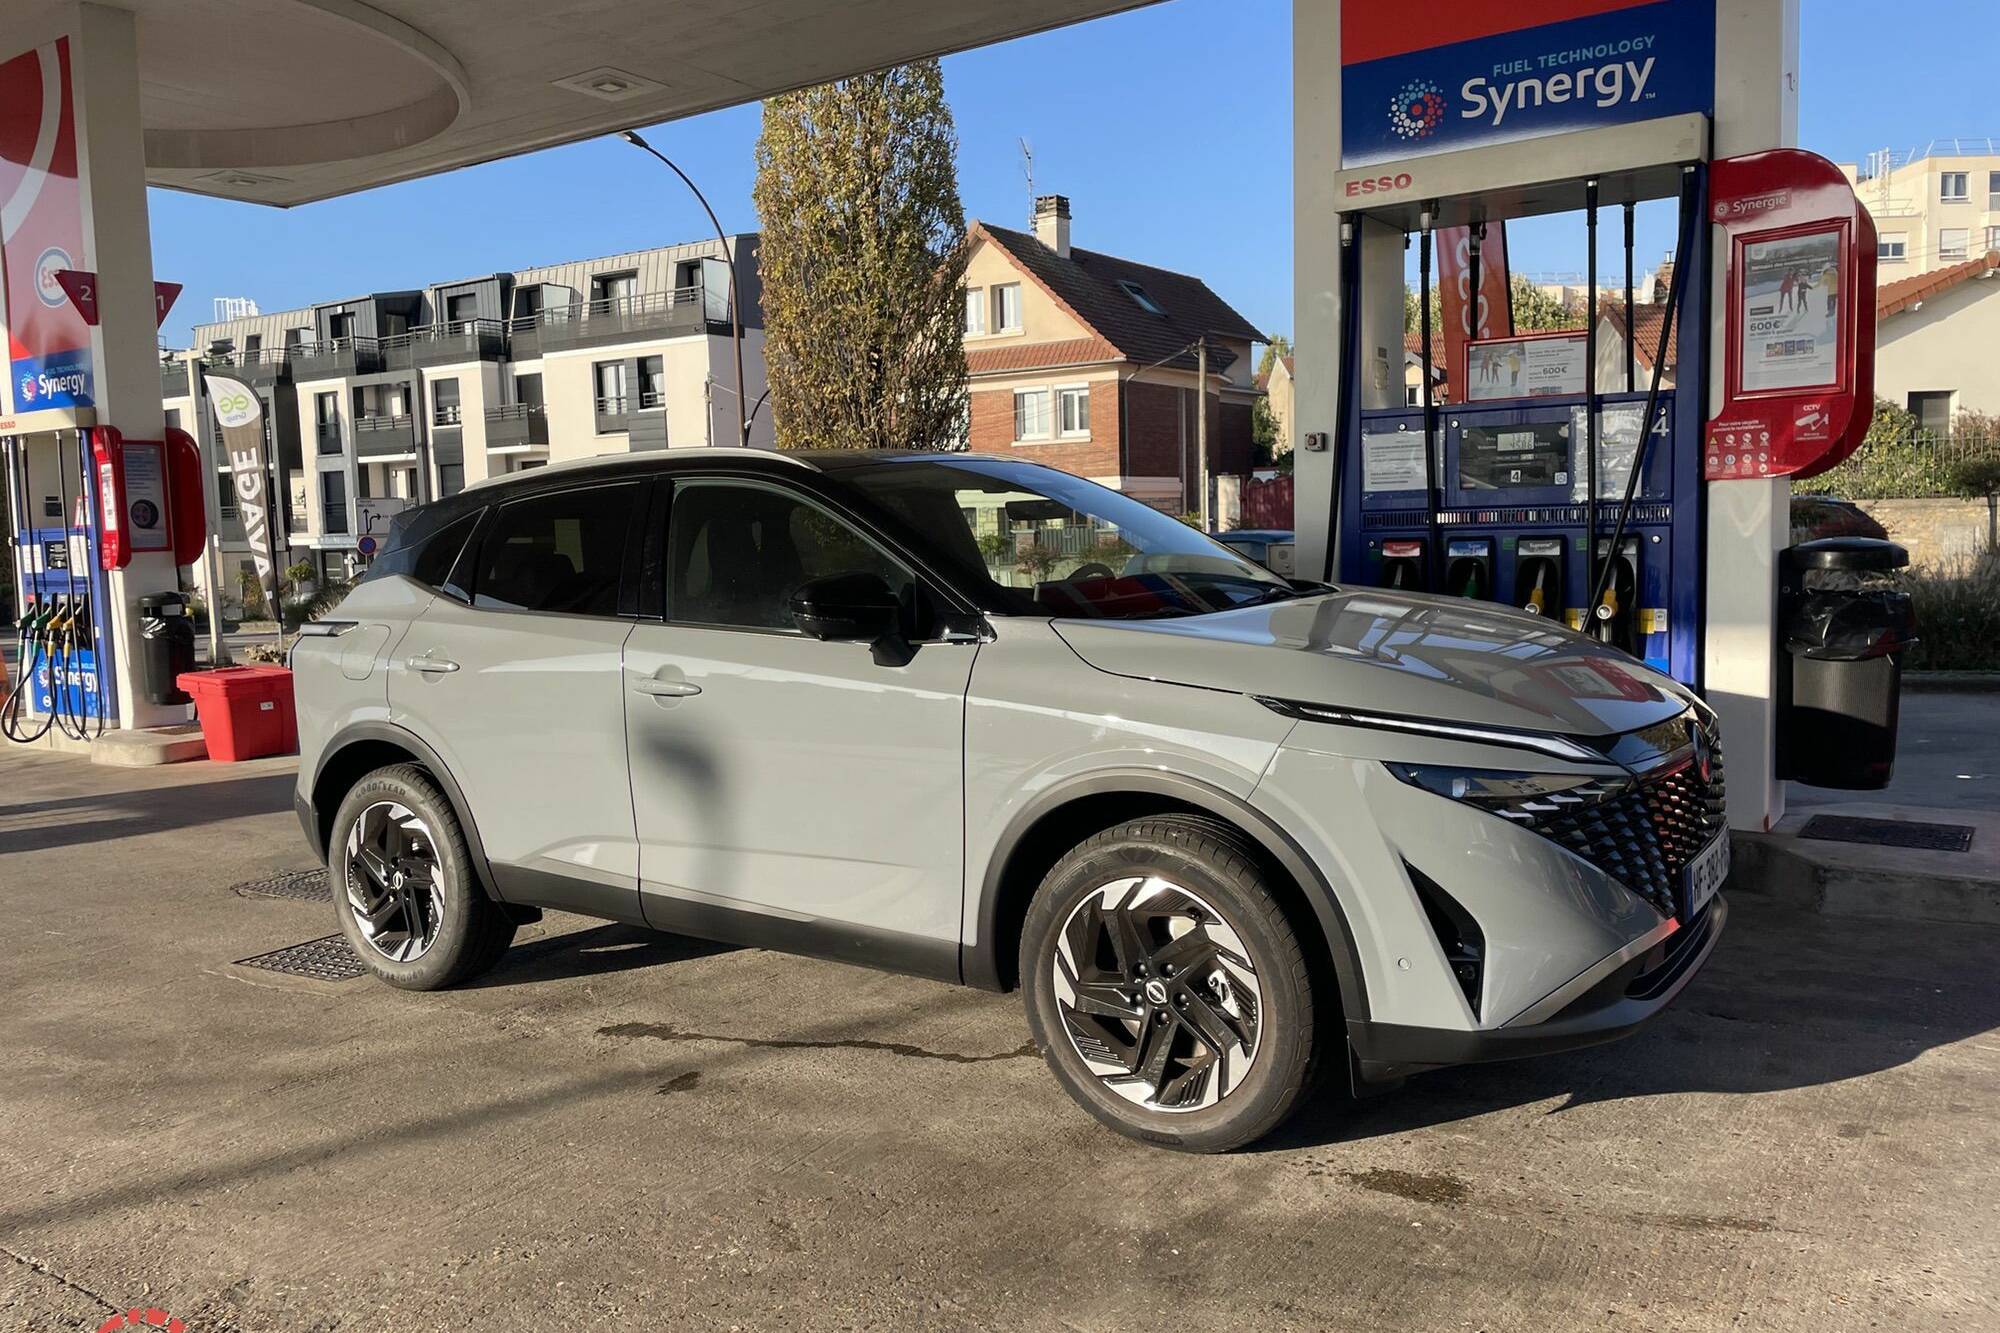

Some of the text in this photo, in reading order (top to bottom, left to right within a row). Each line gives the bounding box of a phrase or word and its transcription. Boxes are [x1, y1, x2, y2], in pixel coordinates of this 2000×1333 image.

[1493, 35, 1655, 77] FUEL TECHNOLOGY
[1461, 57, 1656, 125] Synergy
[1345, 173, 1412, 197] ESSO
[1733, 195, 1787, 214] Synergie
[80, 285, 93, 301] 2
[156, 295, 165, 310] 1
[38, 373, 85, 400] Synergy
[1803, 403, 1821, 411] CCTV
[1651, 415, 1670, 437] 4
